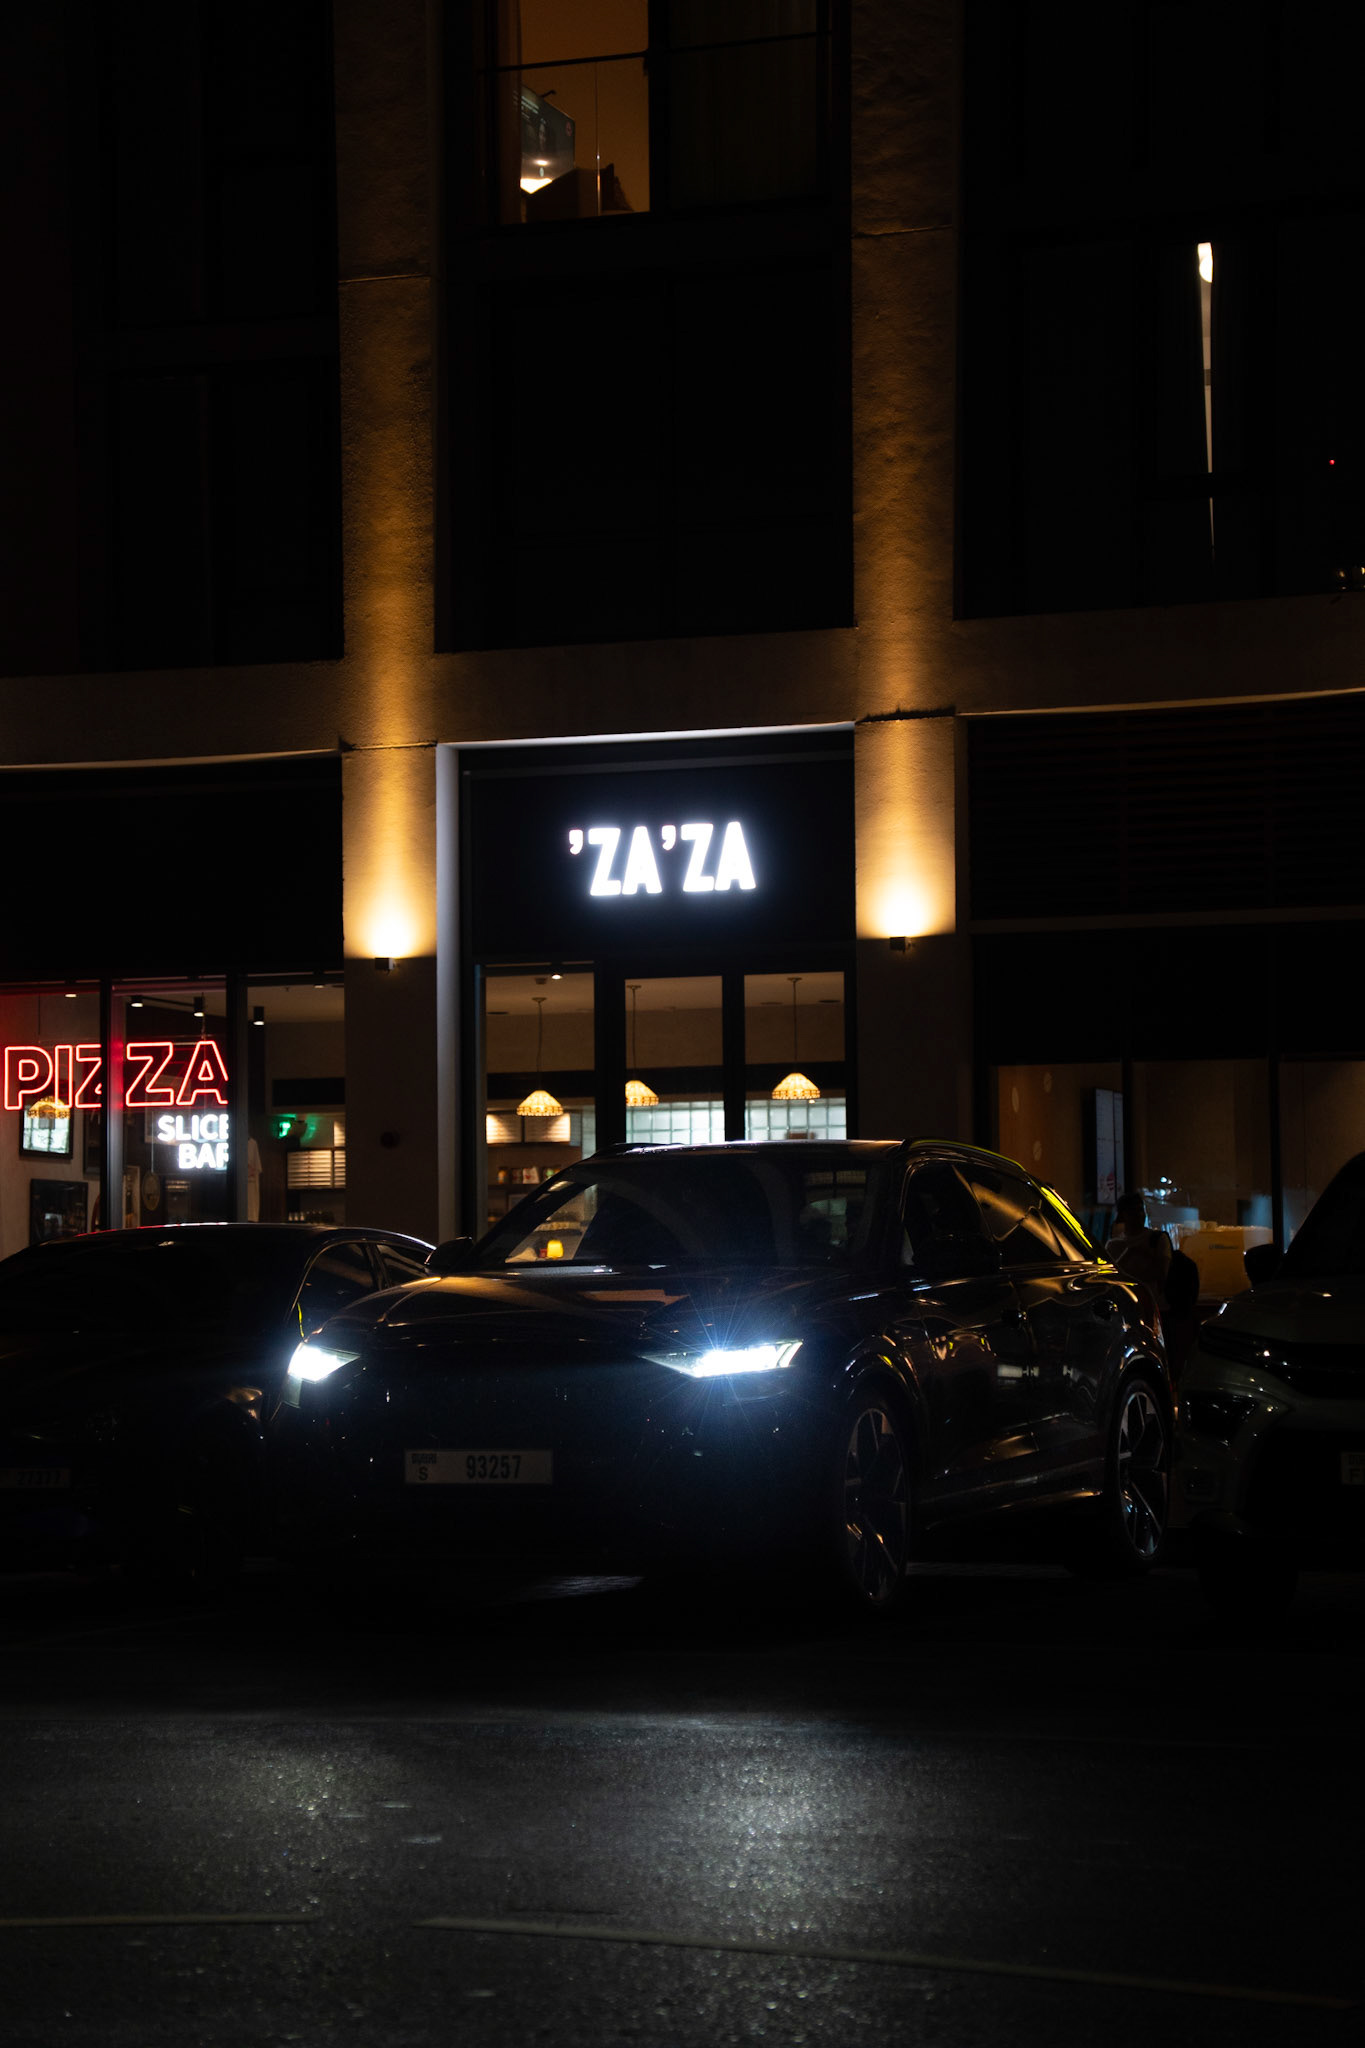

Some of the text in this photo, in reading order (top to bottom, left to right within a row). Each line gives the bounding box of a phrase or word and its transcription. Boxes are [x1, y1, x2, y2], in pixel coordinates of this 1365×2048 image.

[4, 1040, 229, 1110] PIZZA
[419, 1454, 522, 1481] S 93257
